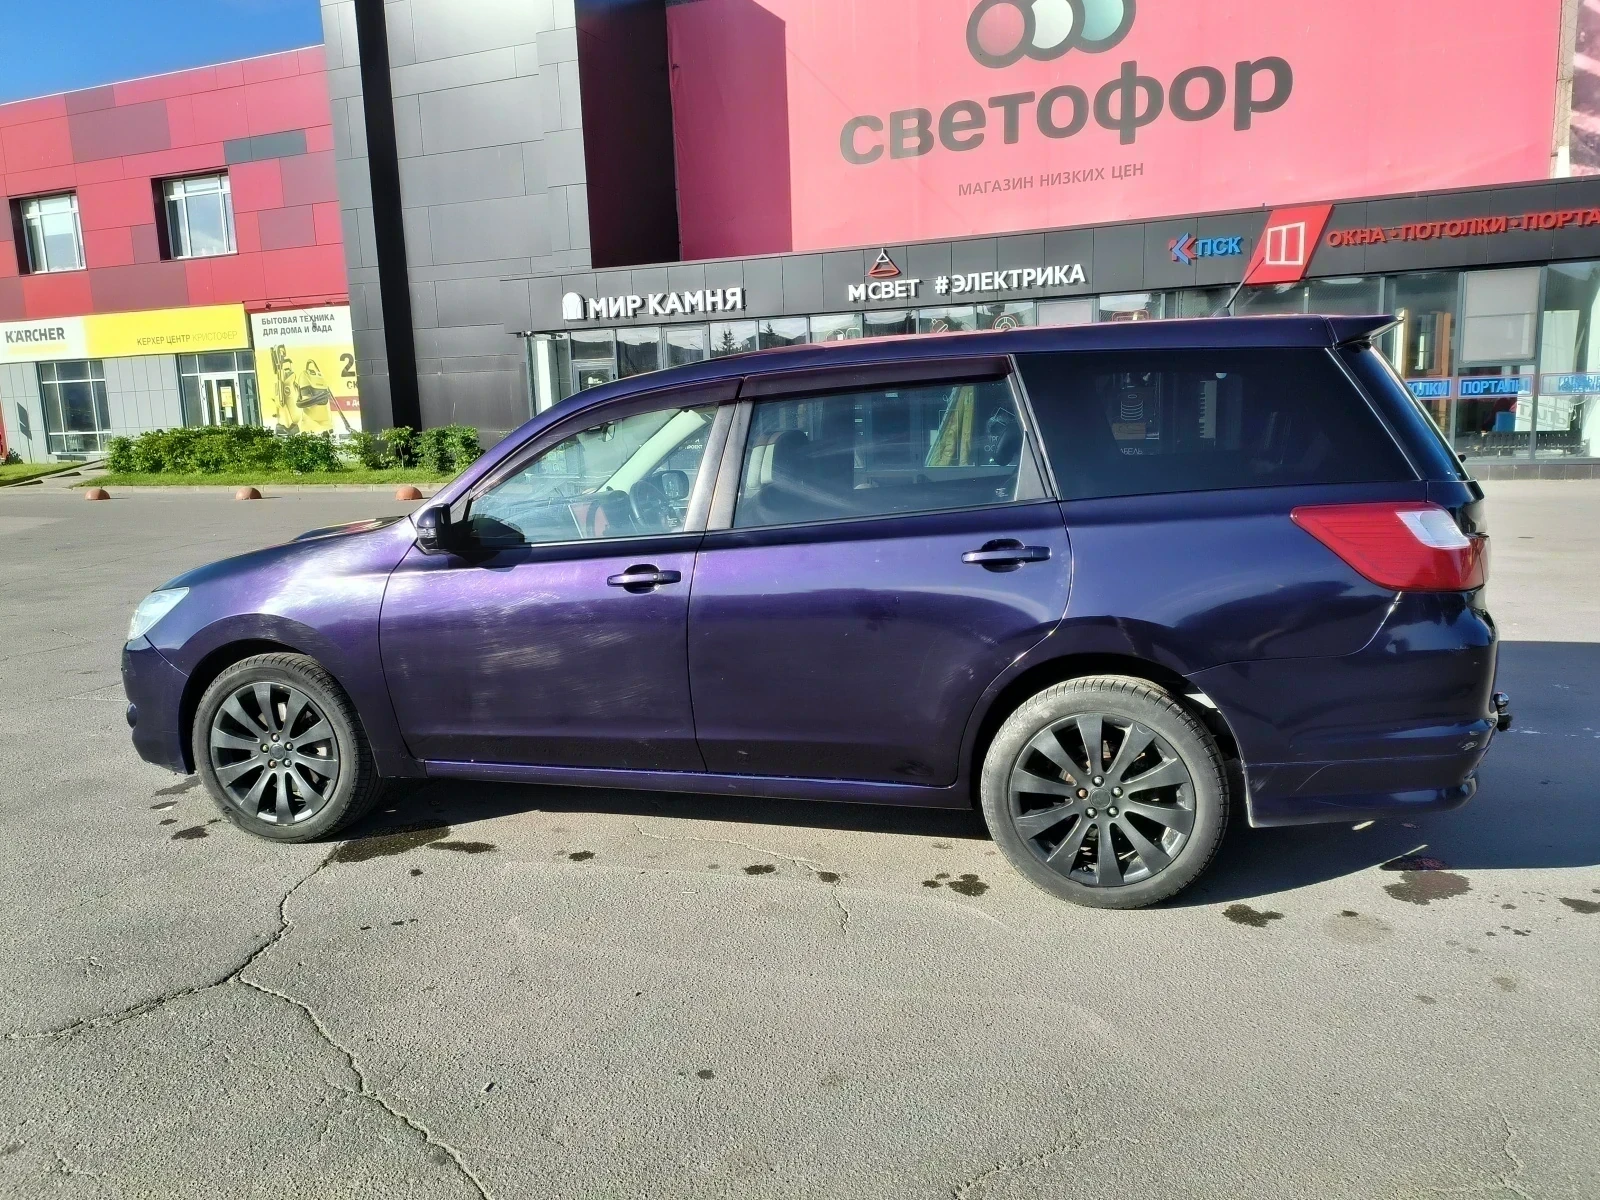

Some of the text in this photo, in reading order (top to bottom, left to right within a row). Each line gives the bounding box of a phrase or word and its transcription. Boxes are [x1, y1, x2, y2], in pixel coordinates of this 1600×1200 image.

[839, 56, 1293, 165] светофор
[958, 163, 1144, 196] МАГАЗИН НИЗКИХ ЦЕН
[1326, 224, 1387, 247] ОКНА
[1400, 215, 1508, 240] ПОТОЛКИ
[1198, 236, 1242, 256] ПСК
[588, 287, 743, 319] МИР КАМНЯ
[261, 313, 335, 326] БЫТОВАЯ ТЕХНИКА
[262, 328, 279, 337] ДЛЯ
[280, 326, 303, 336] ДОМА
[137, 331, 237, 346] КЕРХЕР ЦЕНТР КРИСТОФЕР
